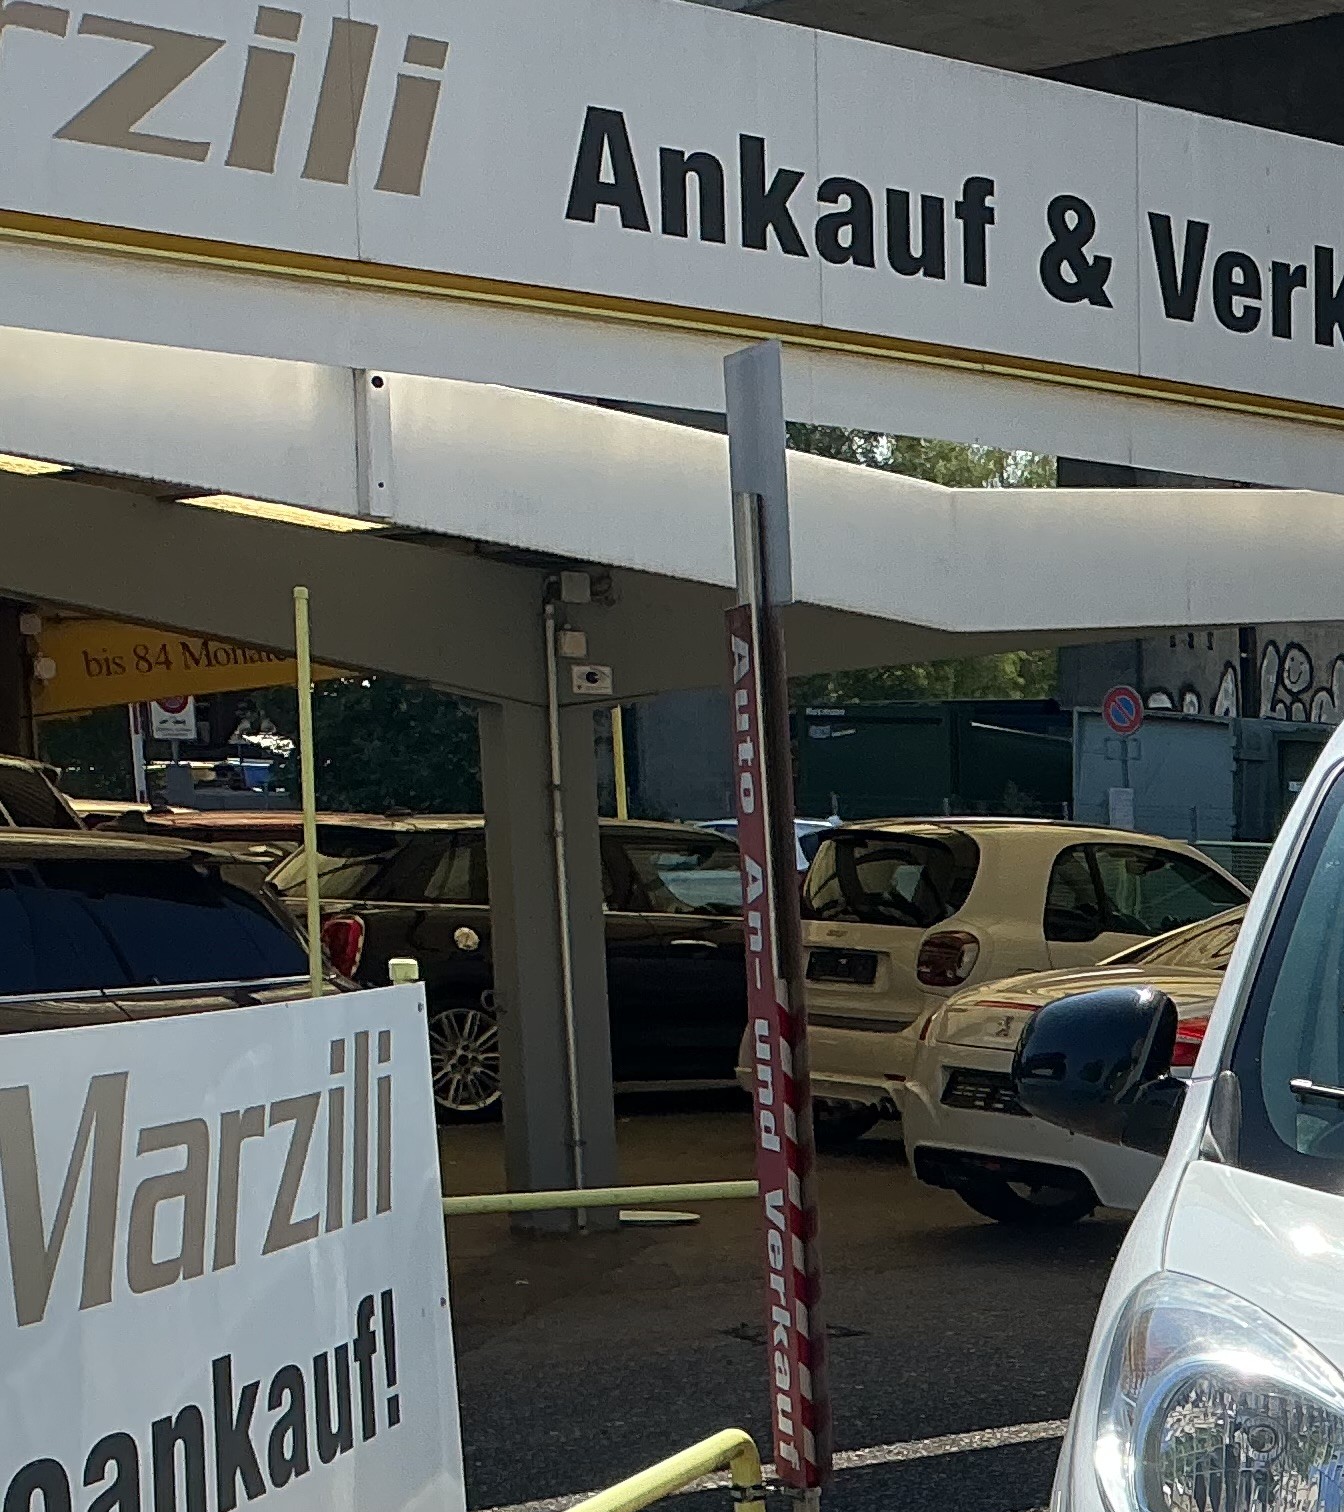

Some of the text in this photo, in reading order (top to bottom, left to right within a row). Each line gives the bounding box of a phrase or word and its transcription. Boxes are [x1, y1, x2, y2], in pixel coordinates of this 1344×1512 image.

[564, 104, 996, 288] Ankauf
[1038, 194, 1114, 310] &
[82, 648, 127, 678] bis
[132, 643, 174, 674] 84
[731, 633, 800, 1472] Auto An- und Verkauf
